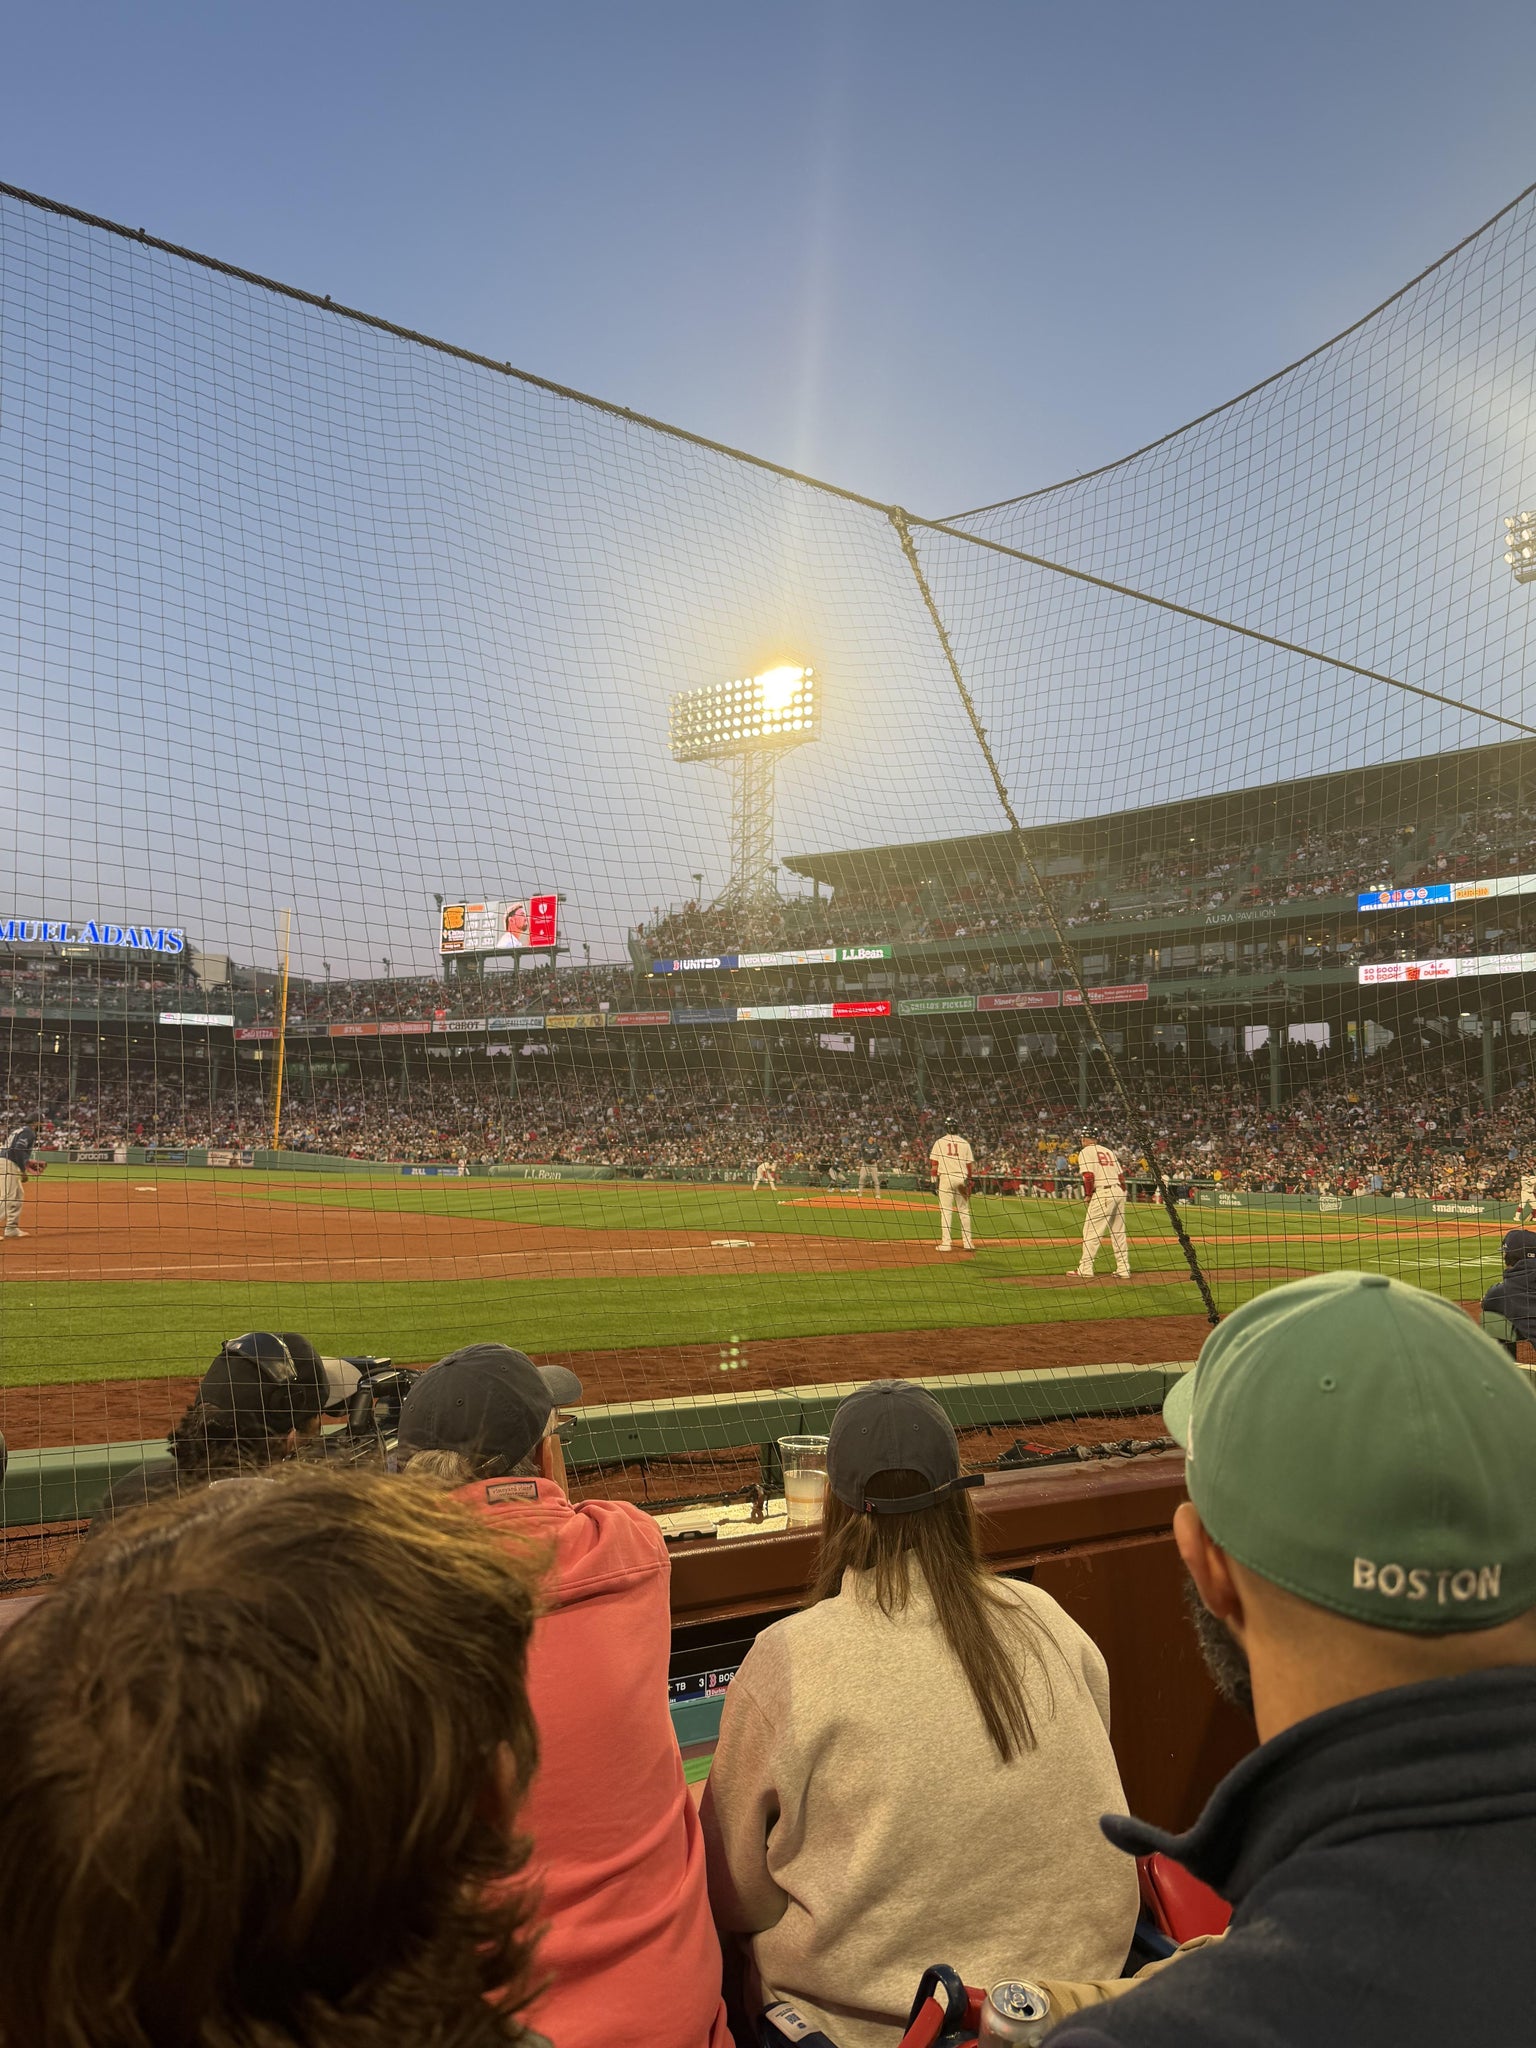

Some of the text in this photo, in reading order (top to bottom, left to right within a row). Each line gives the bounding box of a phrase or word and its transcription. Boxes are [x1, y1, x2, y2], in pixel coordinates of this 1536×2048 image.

[1236, 909, 1276, 921] PAVILION
[77, 919, 184, 954] ADAMS
[682, 958, 721, 971] UNITED
[1364, 973, 1374, 981] SO
[947, 1143, 959, 1156] 11
[1432, 1204, 1485, 1214] smartwater
[1353, 1556, 1502, 1605] BOSTON
[718, 1671, 735, 1683] BOS
[675, 1678, 705, 1692] TB 3
